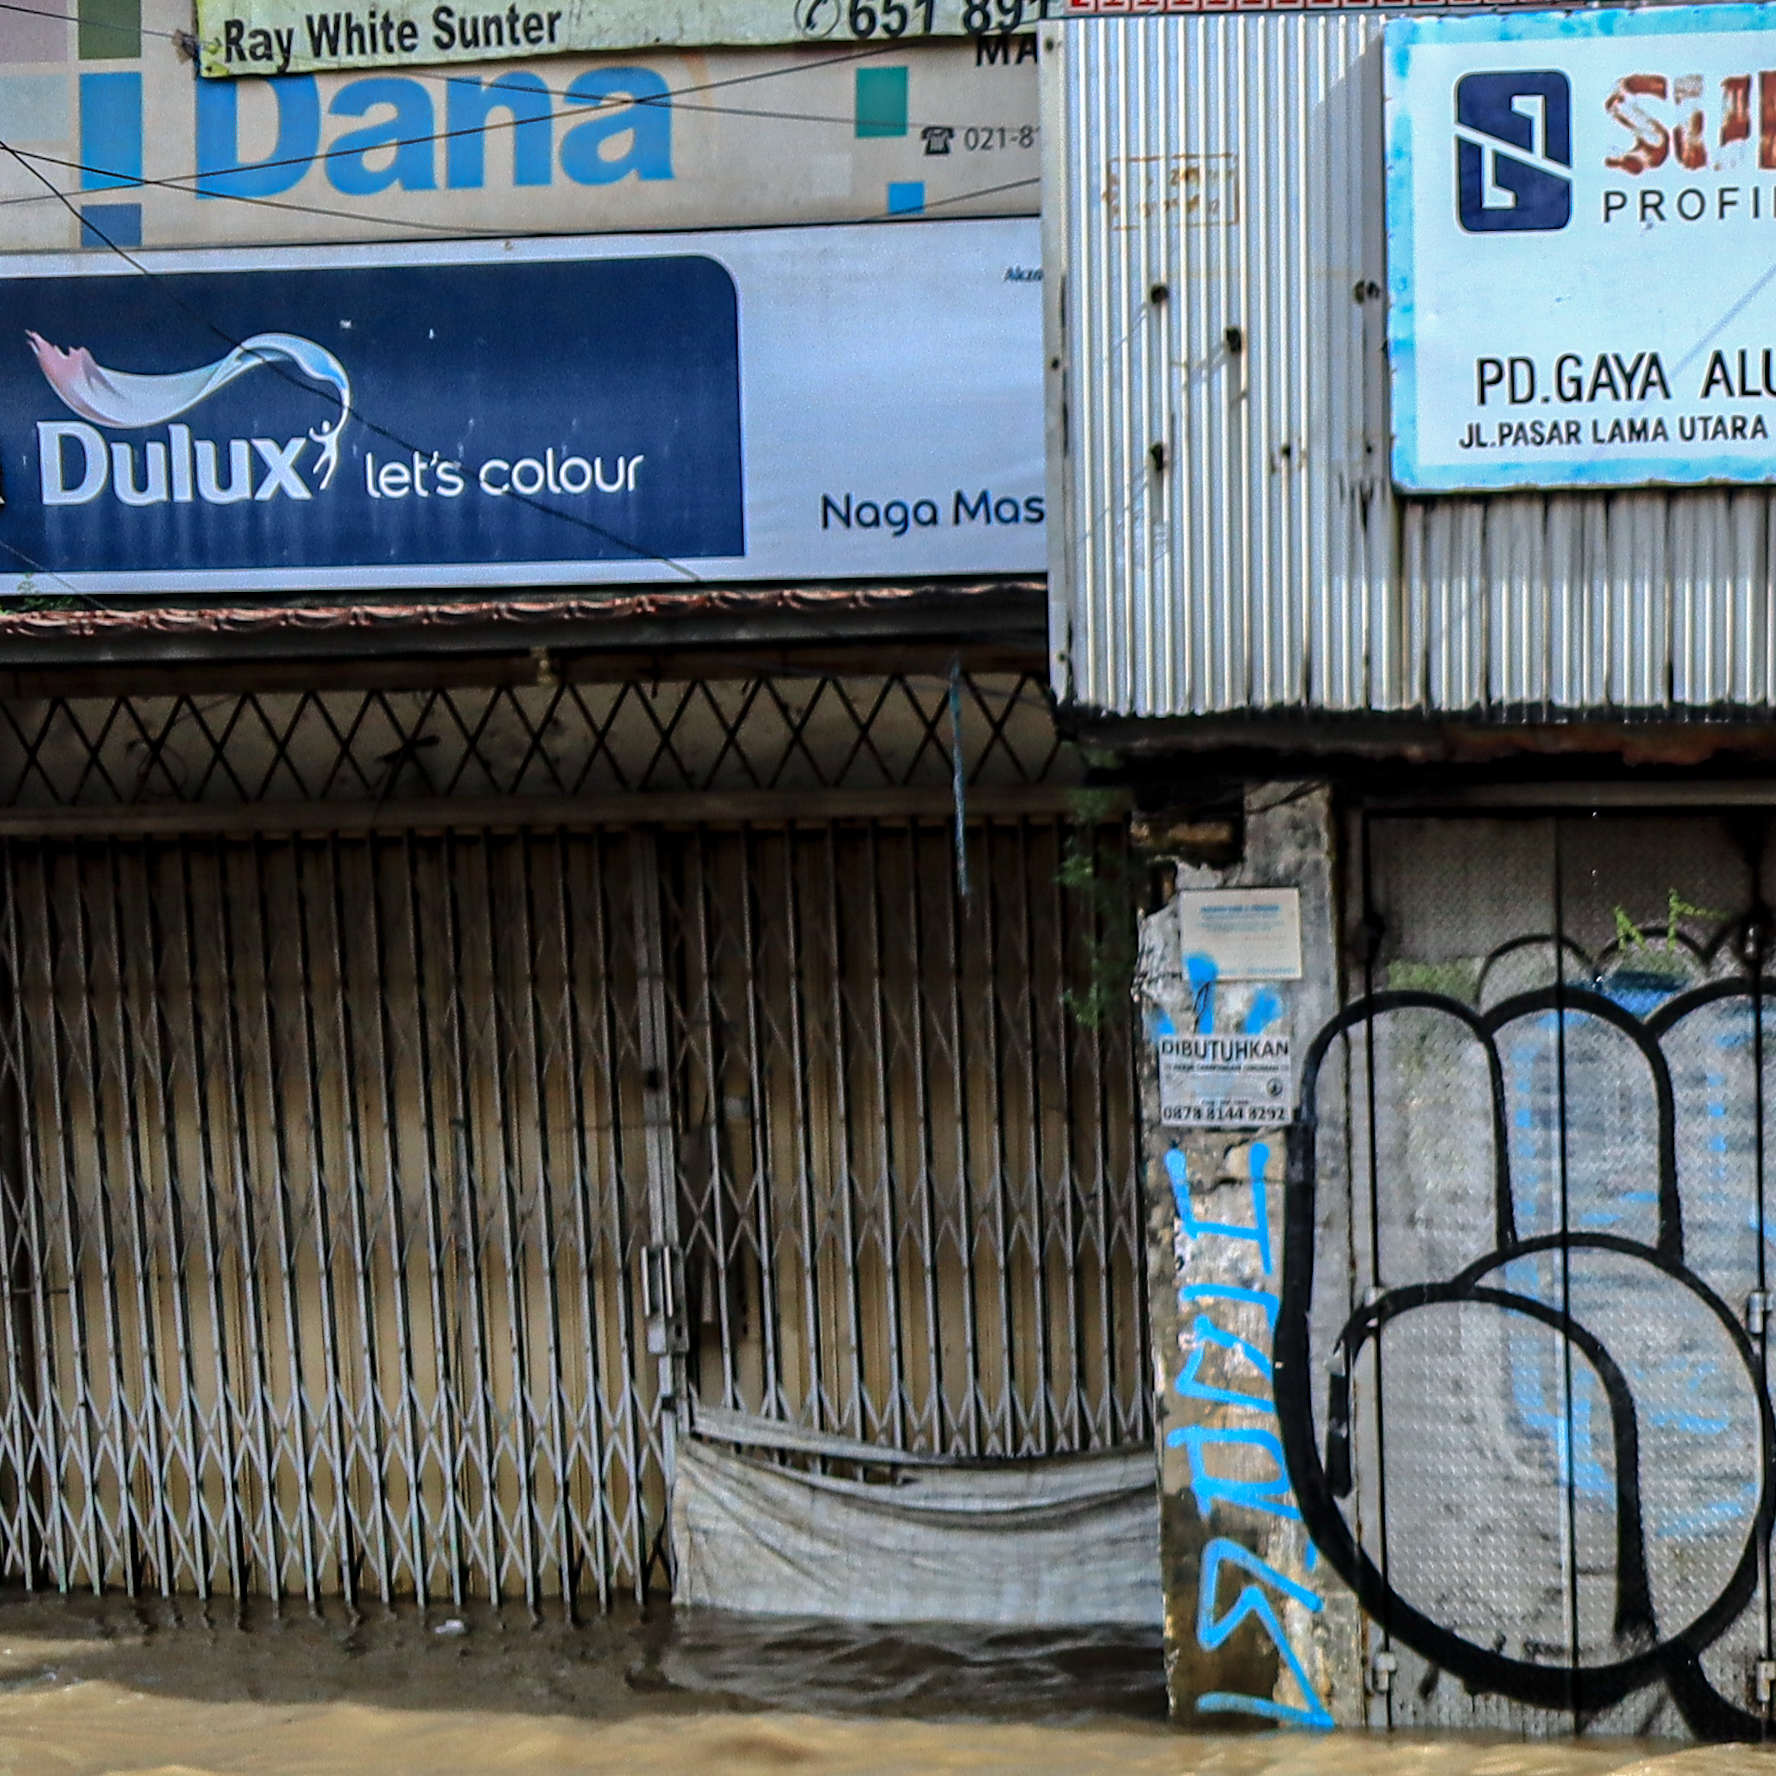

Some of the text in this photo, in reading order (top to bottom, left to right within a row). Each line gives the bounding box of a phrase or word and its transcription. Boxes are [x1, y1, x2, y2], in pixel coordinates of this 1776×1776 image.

[224, 5, 563, 73] Ray White Sunter
[851, 0, 934, 37] 651
[195, 66, 675, 200] Dana
[963, 125, 1040, 150] 021-8
[1592, 416, 1670, 444] LAMA
[1679, 413, 1769, 441] UTARA
[37, 421, 312, 506] Dulux
[365, 448, 646, 498] let's colour
[820, 488, 1046, 537] Naga Mas
[1160, 1039, 1290, 1062] DIBUTUHKAN
